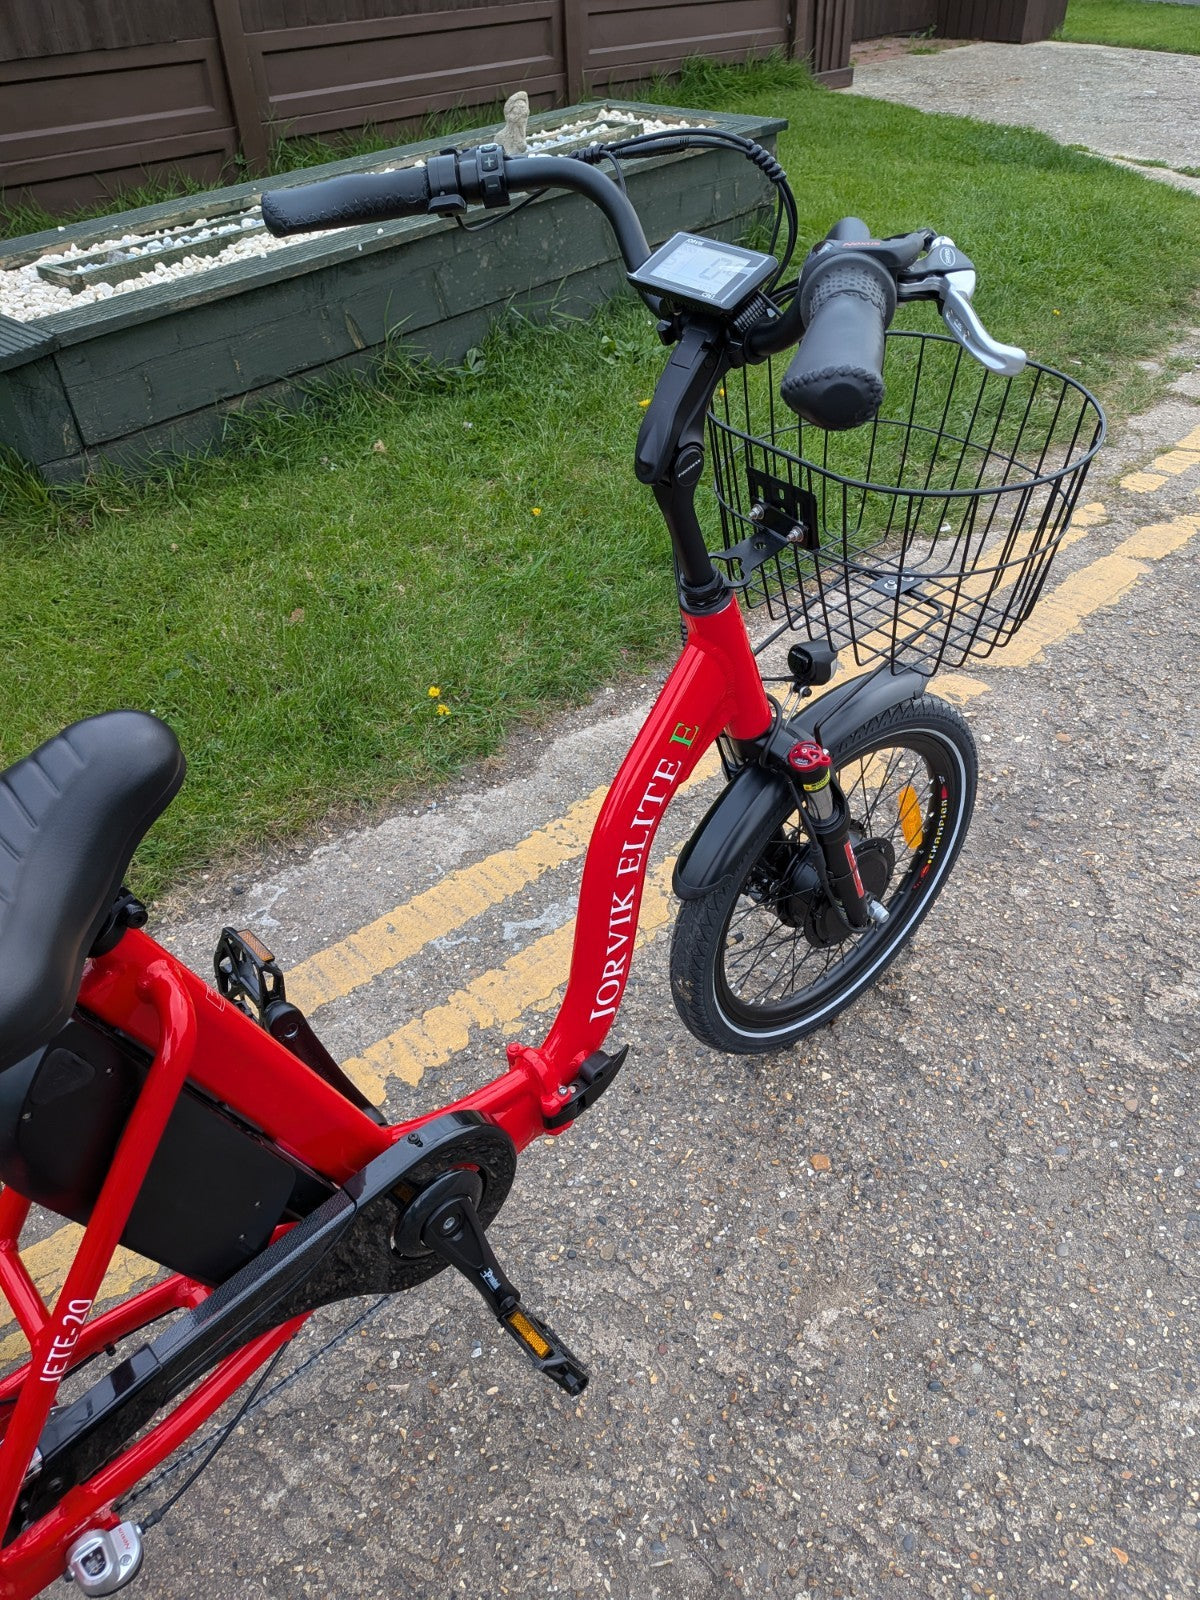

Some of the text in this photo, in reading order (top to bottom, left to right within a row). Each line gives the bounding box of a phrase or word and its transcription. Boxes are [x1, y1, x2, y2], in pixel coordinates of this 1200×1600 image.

[589, 721, 700, 1023] JORVIK ELITE E
[39, 1299, 93, 1382] JETE-20
